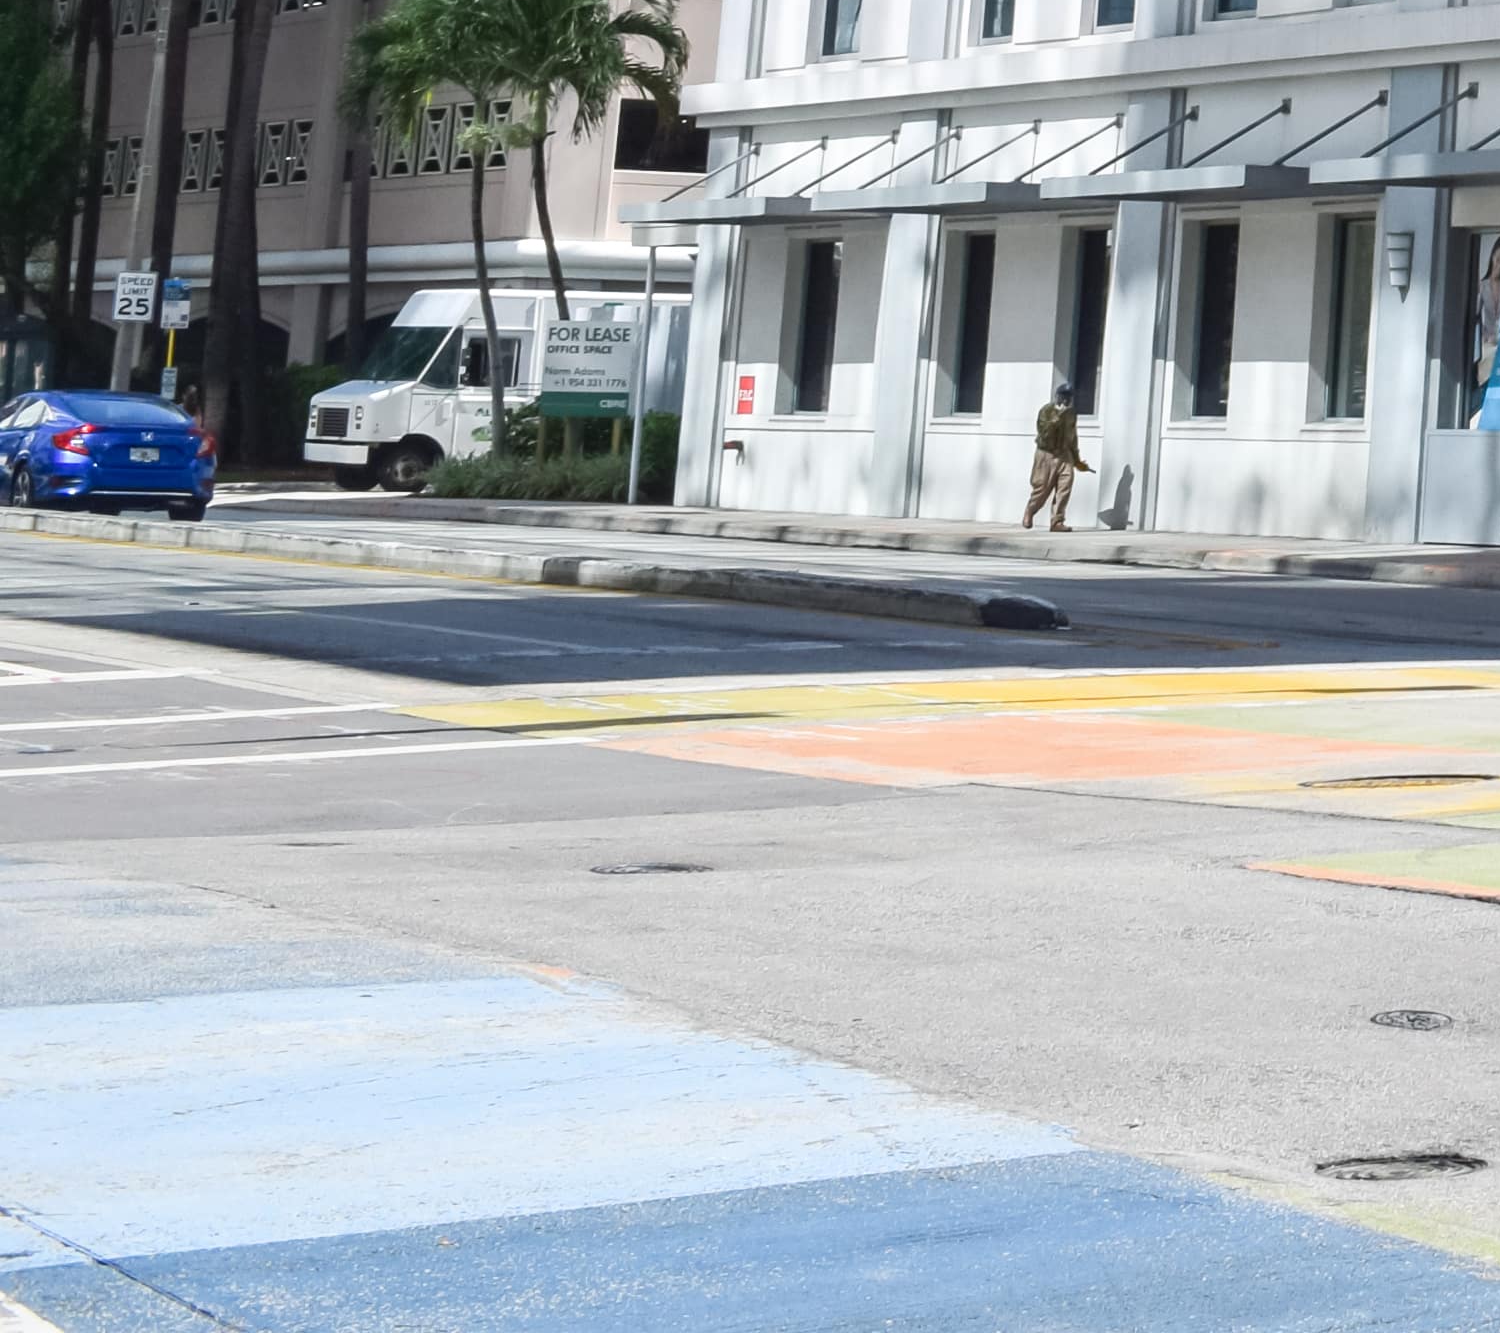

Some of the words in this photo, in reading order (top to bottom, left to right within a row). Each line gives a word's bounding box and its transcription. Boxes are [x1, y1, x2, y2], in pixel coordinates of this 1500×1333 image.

[120, 277, 153, 286] SPEED
[122, 287, 149, 295] LIMIT
[118, 297, 149, 315] 25
[549, 327, 580, 341] FOR
[585, 327, 631, 342] LEASE
[547, 345, 579, 353] OFFICE
[584, 345, 612, 354] SPACE
